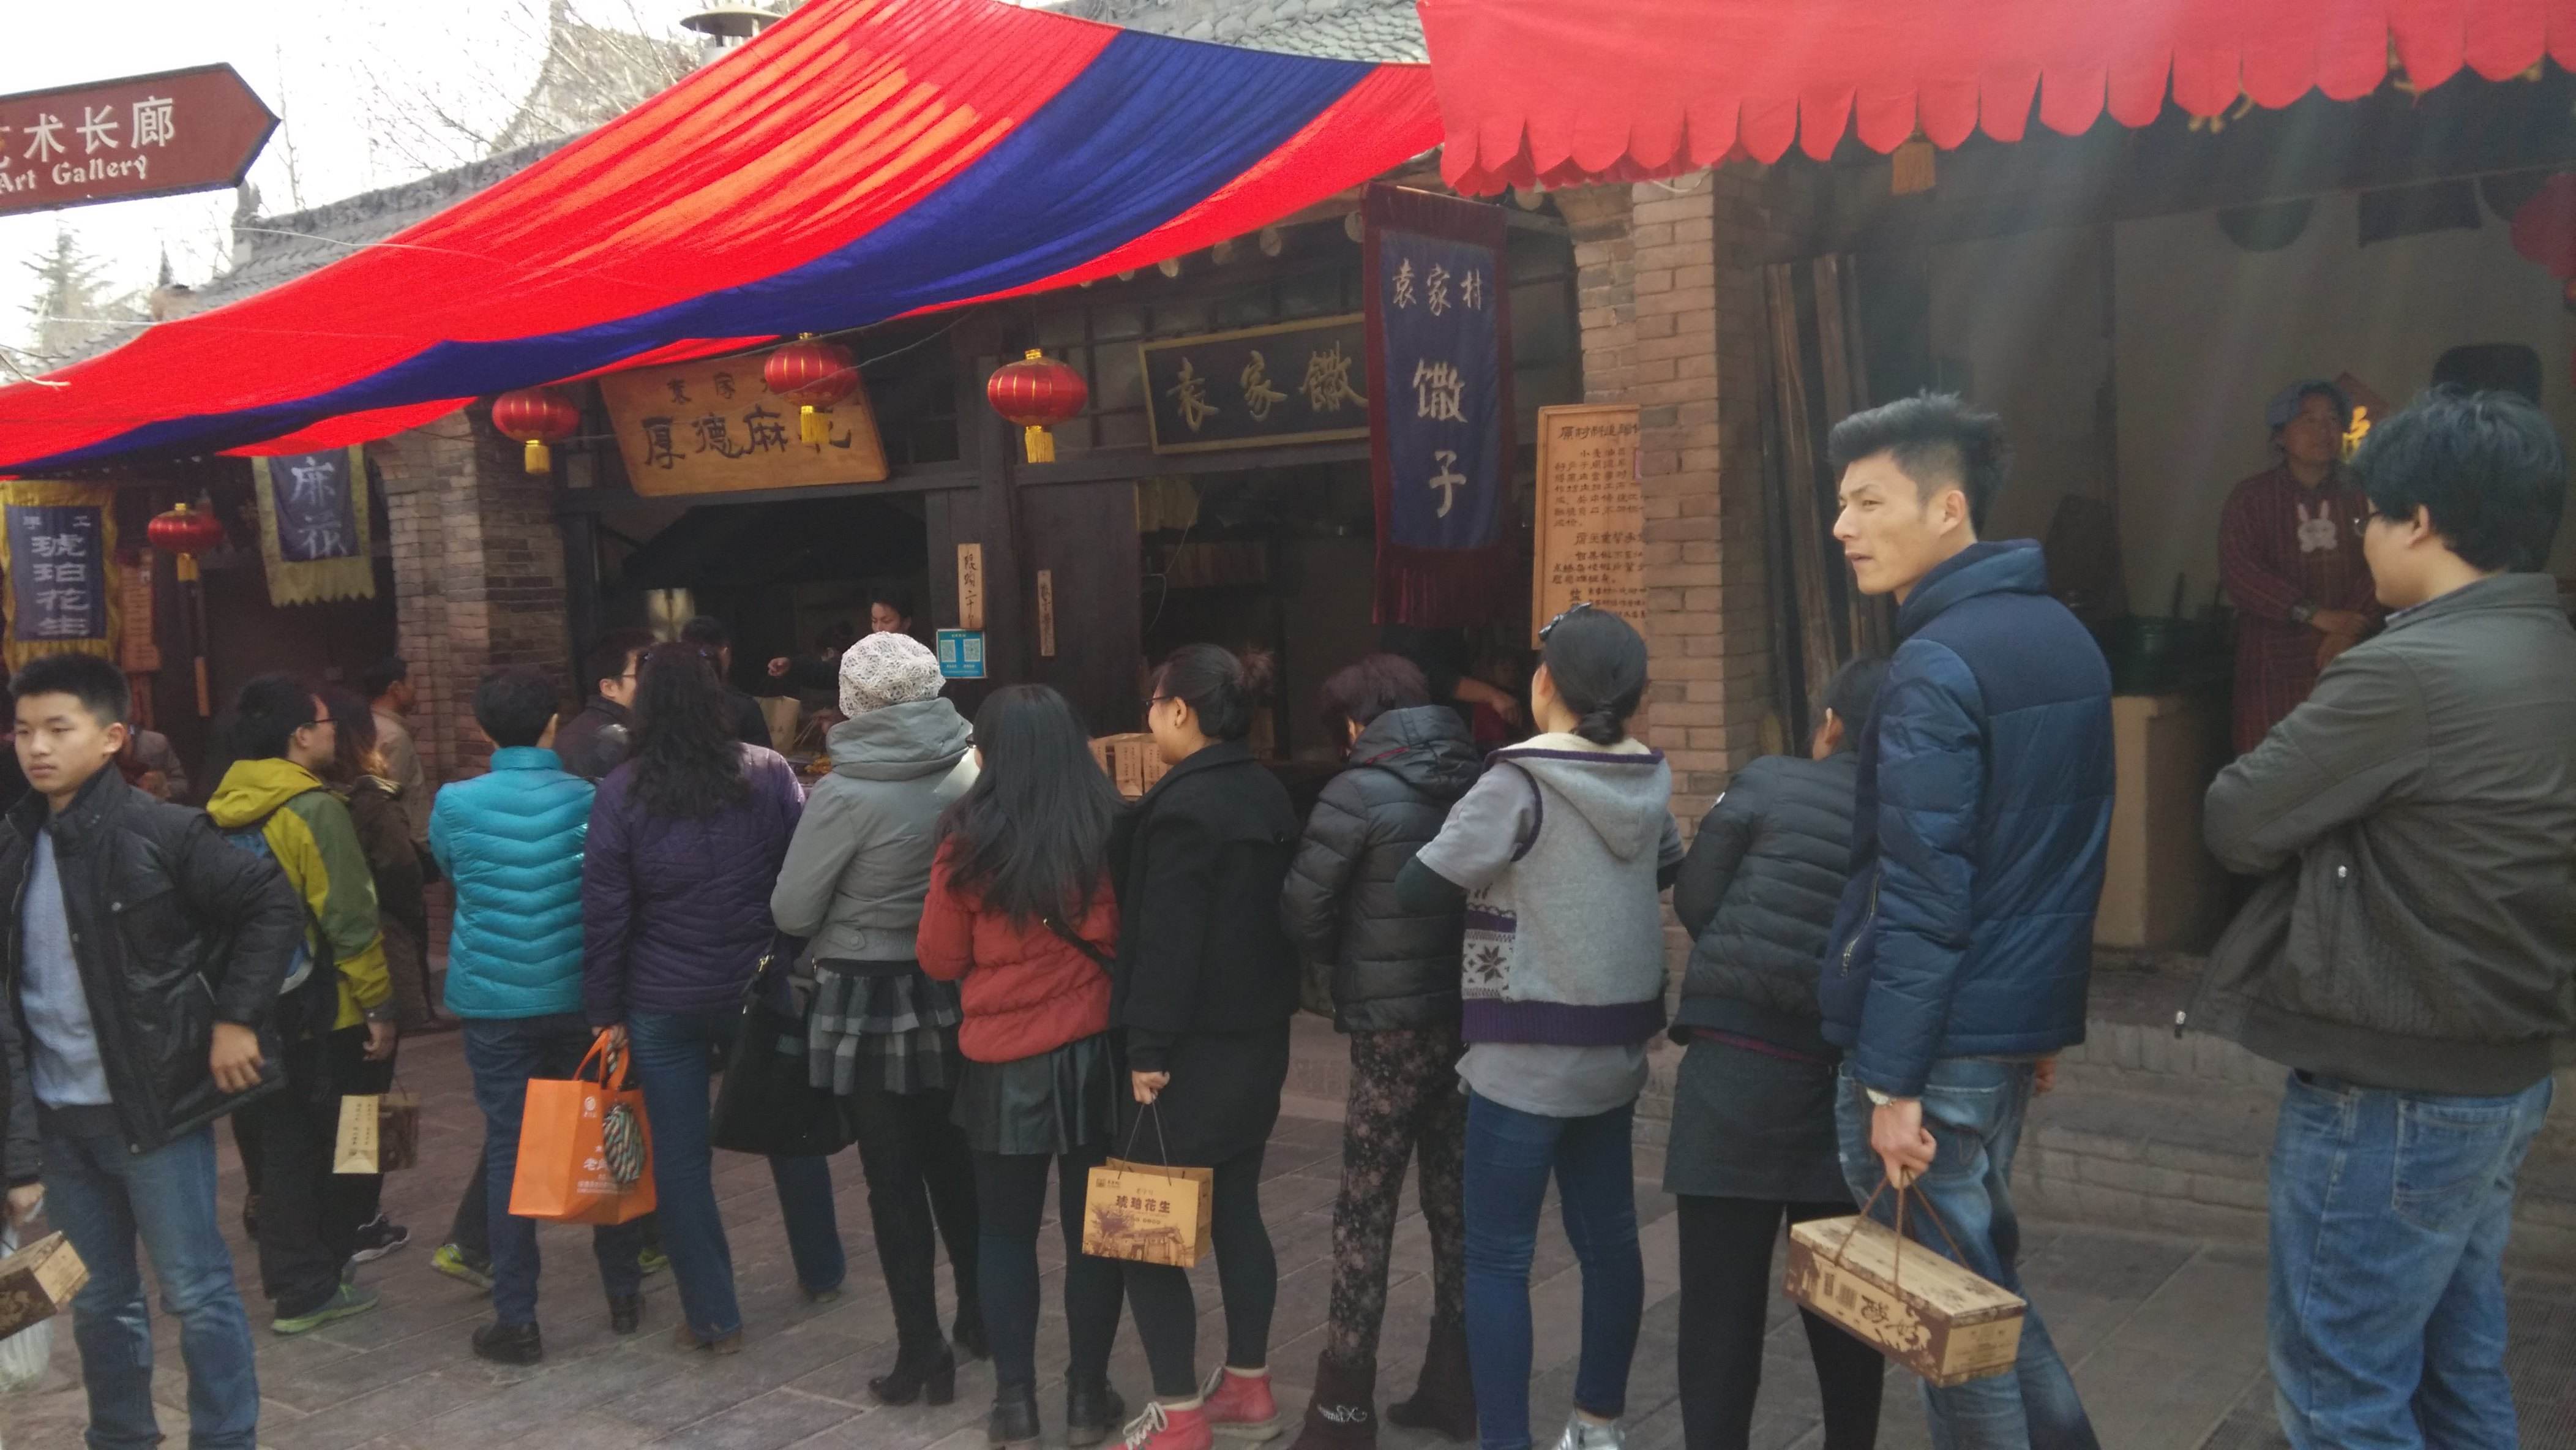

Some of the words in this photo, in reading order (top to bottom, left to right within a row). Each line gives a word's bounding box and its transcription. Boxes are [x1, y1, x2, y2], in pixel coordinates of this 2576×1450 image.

[0, 96, 176, 169] 术长廊
[0, 169, 37, 195] Art
[51, 154, 148, 186] Gallery
[1391, 257, 1483, 317] 袁家村
[1115, 1195, 1171, 1214] 琥珀花生
